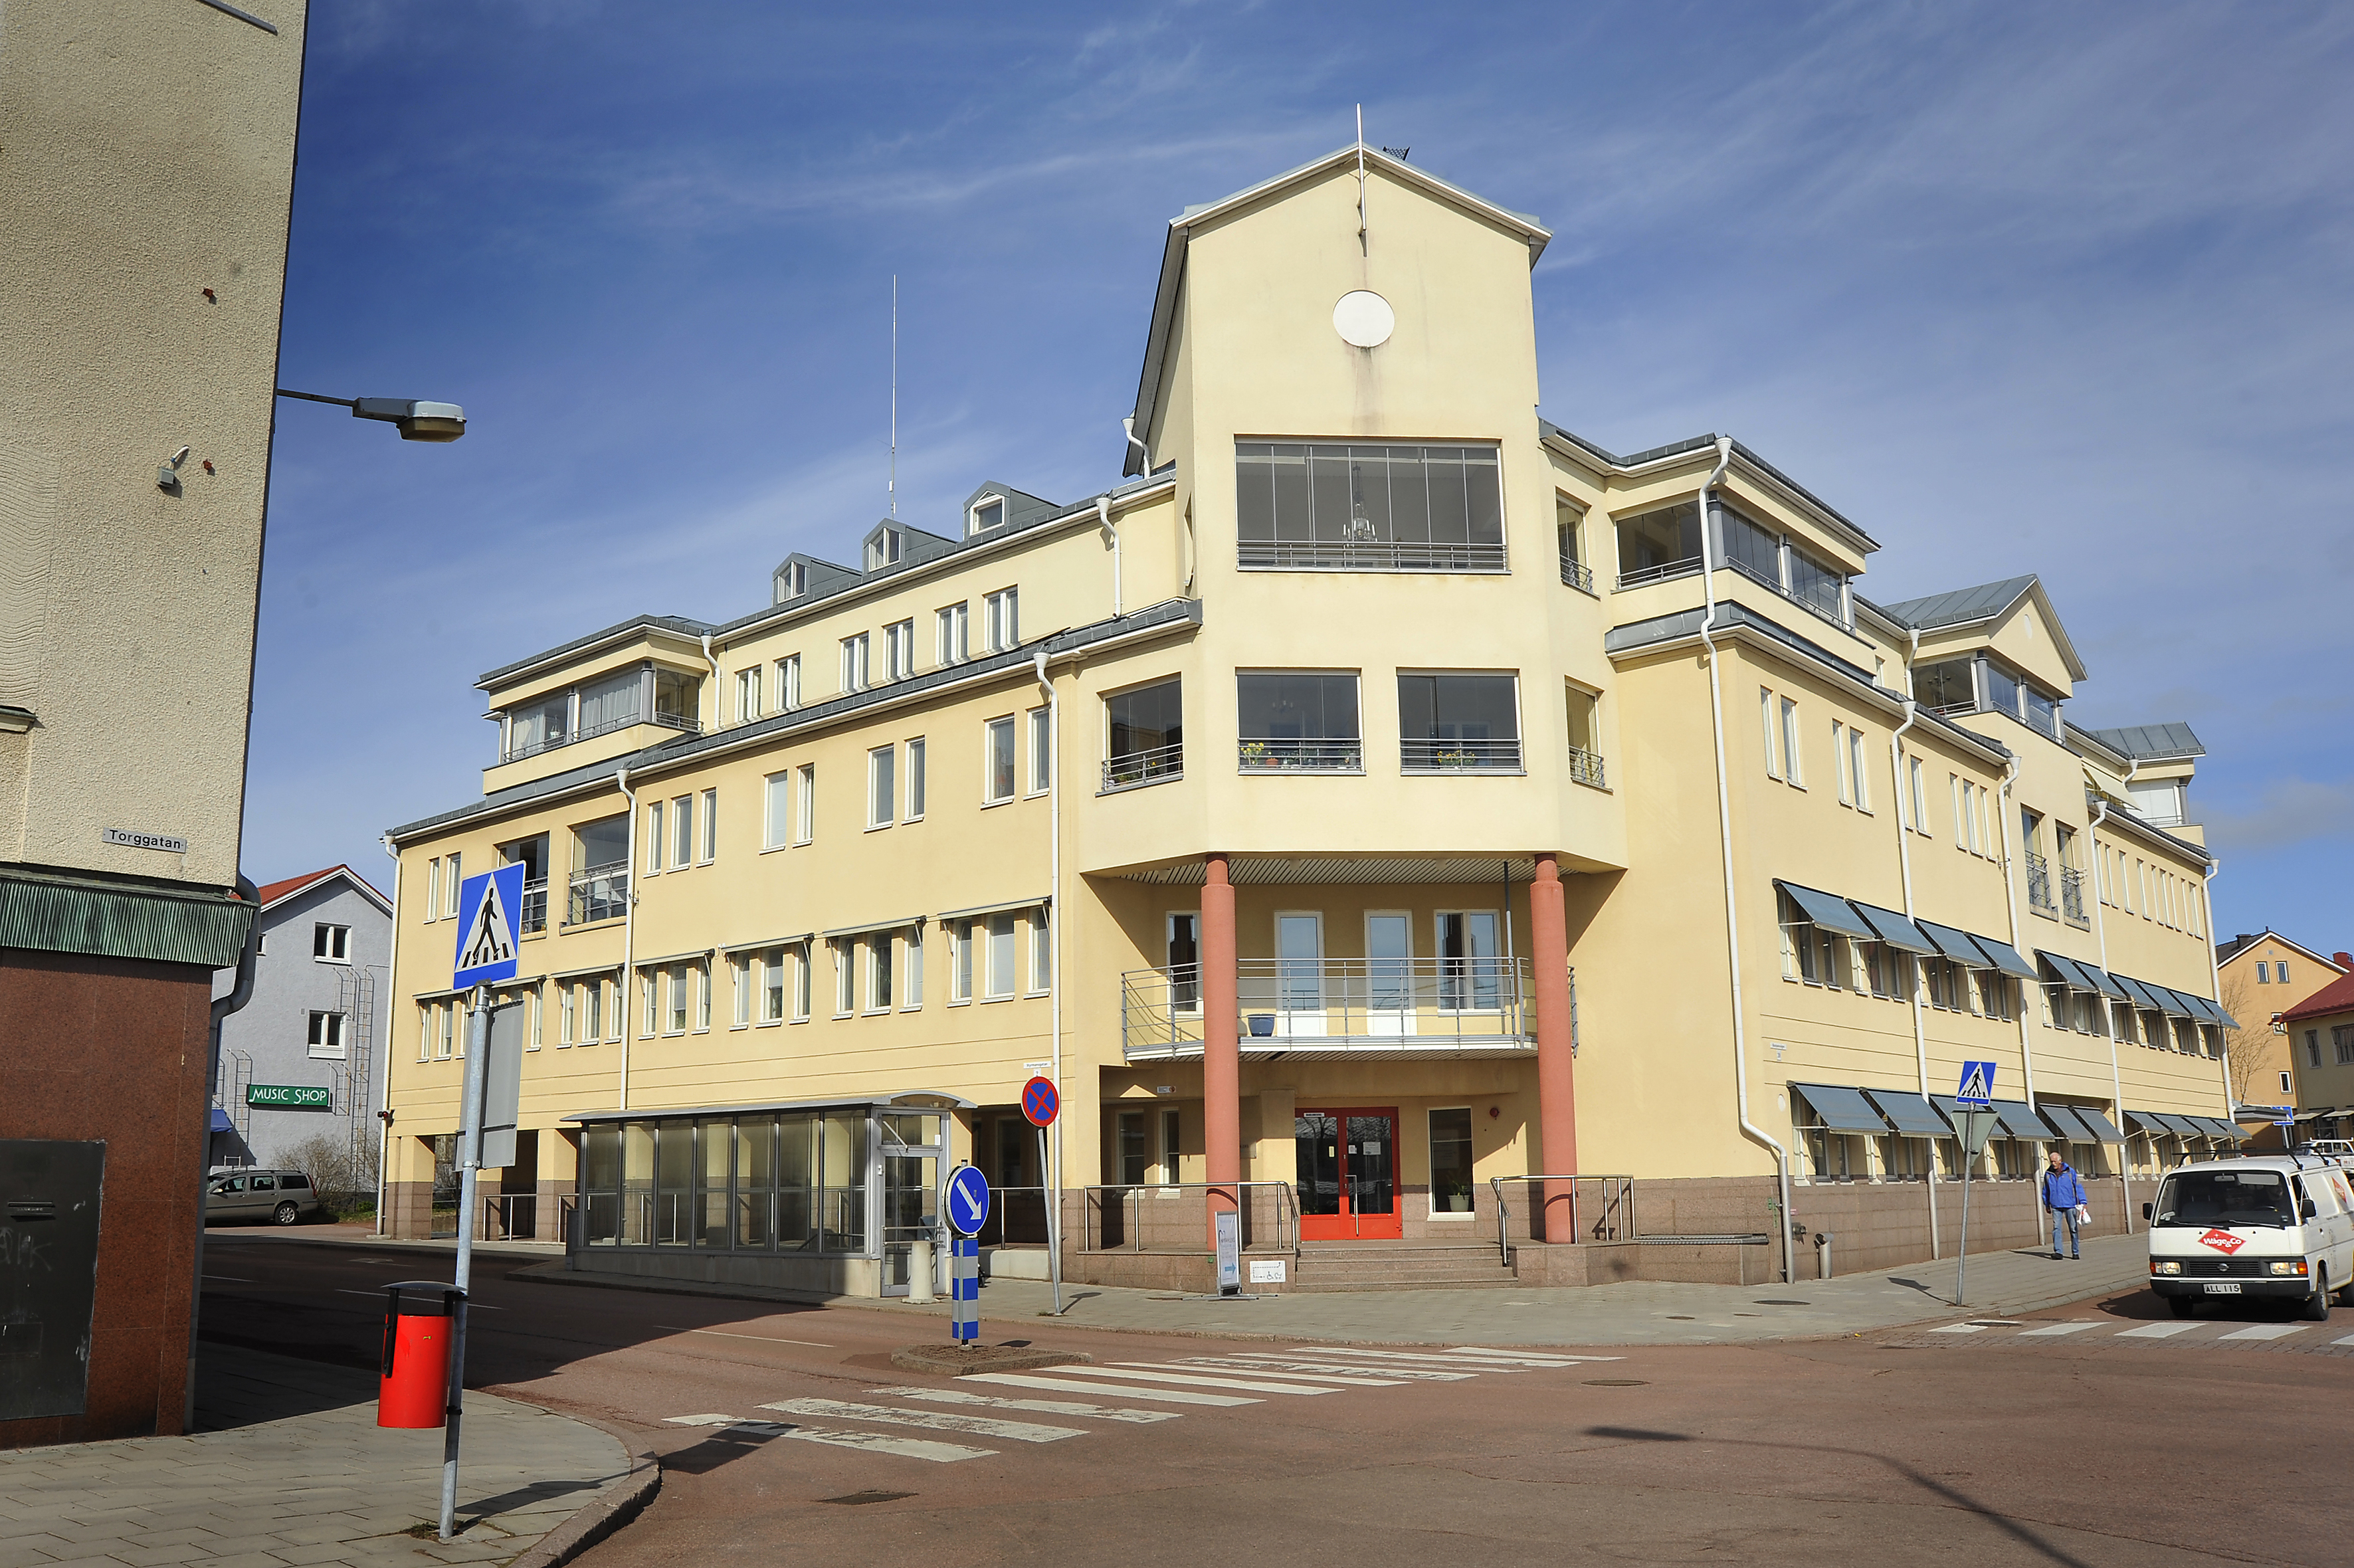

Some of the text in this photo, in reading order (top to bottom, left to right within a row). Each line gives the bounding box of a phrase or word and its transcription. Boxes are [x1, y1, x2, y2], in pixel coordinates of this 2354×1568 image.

[110, 830, 180, 848] Torggatan
[248, 1088, 326, 1104] MUSIC SHOP
